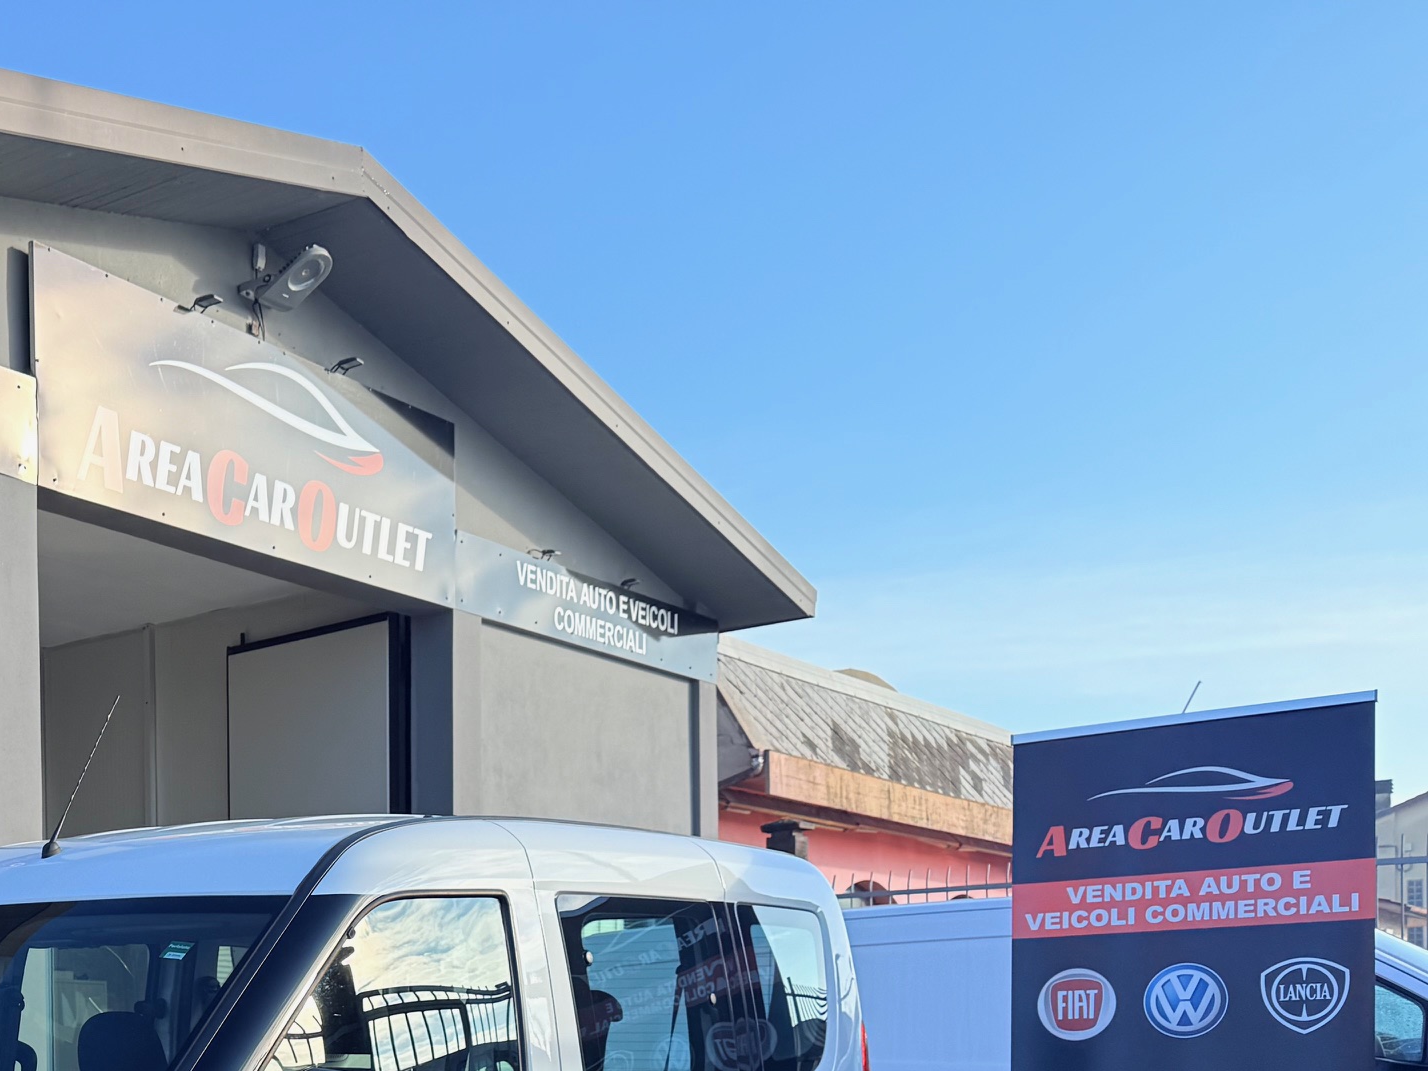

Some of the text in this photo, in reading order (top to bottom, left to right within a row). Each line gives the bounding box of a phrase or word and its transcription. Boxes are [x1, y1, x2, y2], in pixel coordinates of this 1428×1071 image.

[516, 560, 678, 635] VENDITA AUTO E VEICOLI
[553, 606, 647, 656] COMMERCIALI
[1066, 870, 1311, 904] VENDITA AUTO E
[1025, 892, 1360, 931] VEICOLI COMMERCIALI
[1057, 988, 1099, 1021] FIAT
[1277, 983, 1332, 1003] LANCIA
